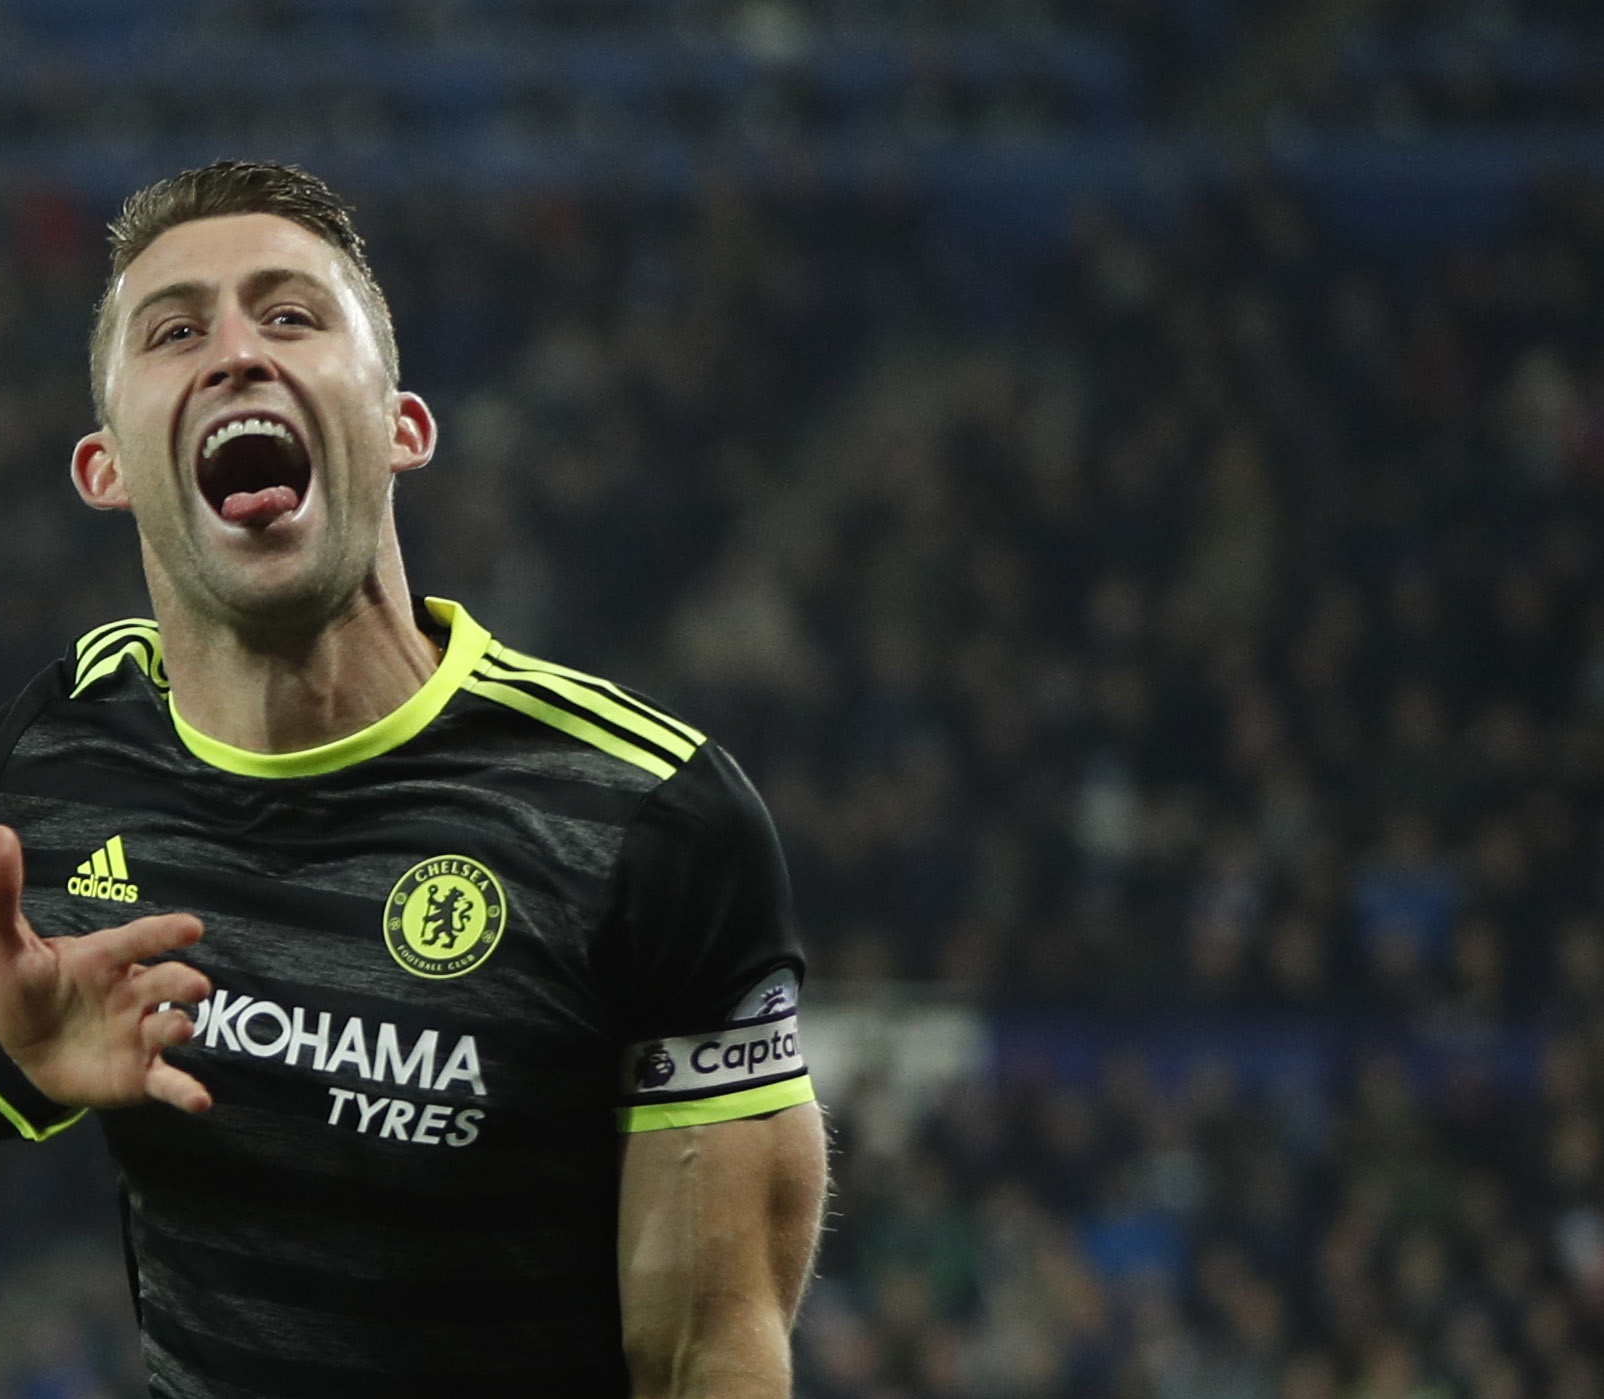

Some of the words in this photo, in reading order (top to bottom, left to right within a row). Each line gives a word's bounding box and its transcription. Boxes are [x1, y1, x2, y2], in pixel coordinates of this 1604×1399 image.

[67, 873, 139, 903] adidas
[414, 860, 490, 891] CHELSEA
[158, 989, 488, 1097] KOHAMA
[327, 1087, 486, 1148] TYRES
